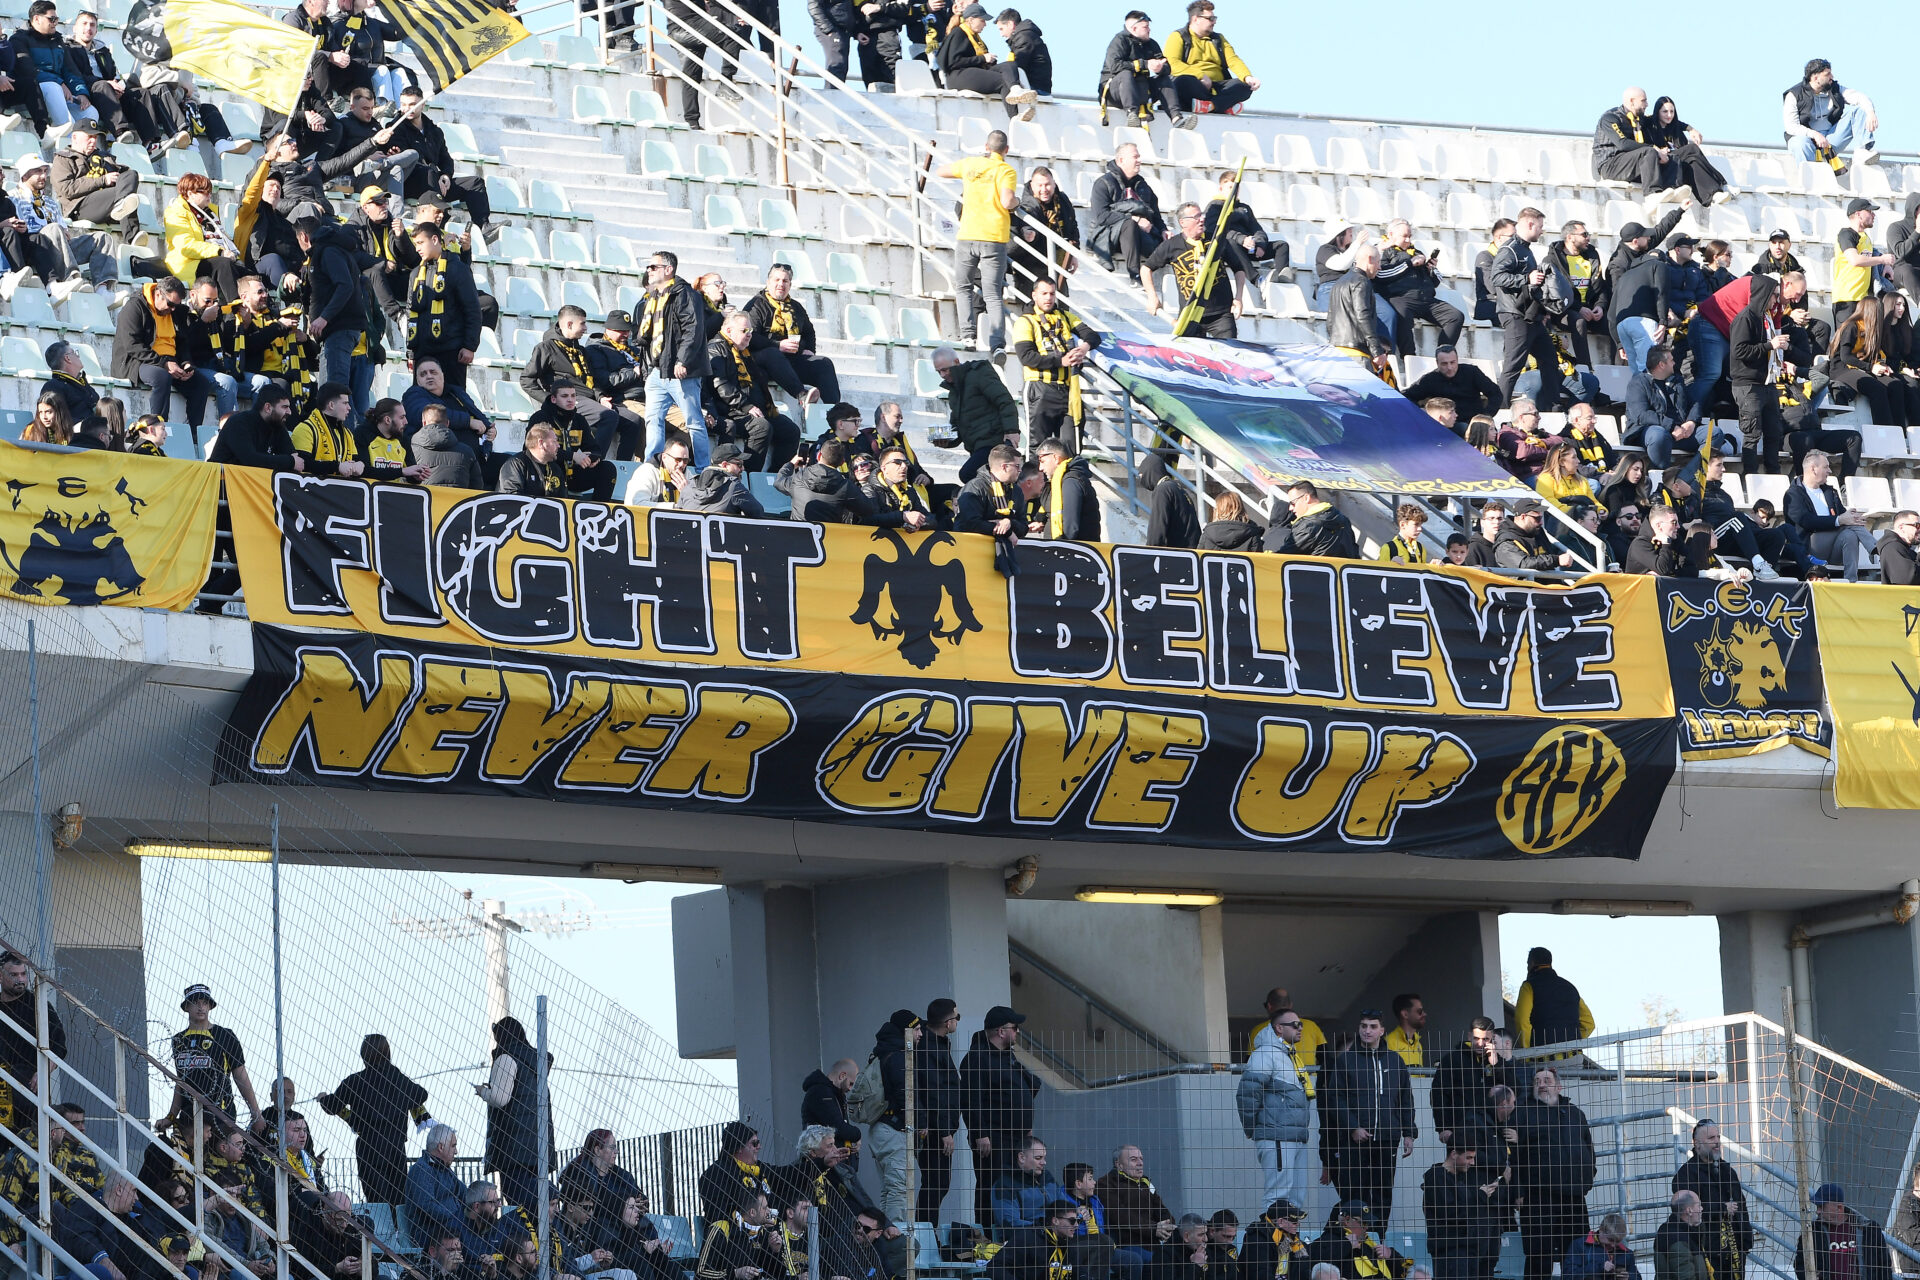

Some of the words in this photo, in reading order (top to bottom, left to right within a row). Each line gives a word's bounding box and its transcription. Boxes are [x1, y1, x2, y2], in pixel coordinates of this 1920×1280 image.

[273, 470, 825, 661] FIGHT
[1008, 538, 1622, 712] BELIEVE
[249, 645, 798, 803] NEVER
[815, 689, 1210, 833] GIVE
[1229, 714, 1478, 846] UP
